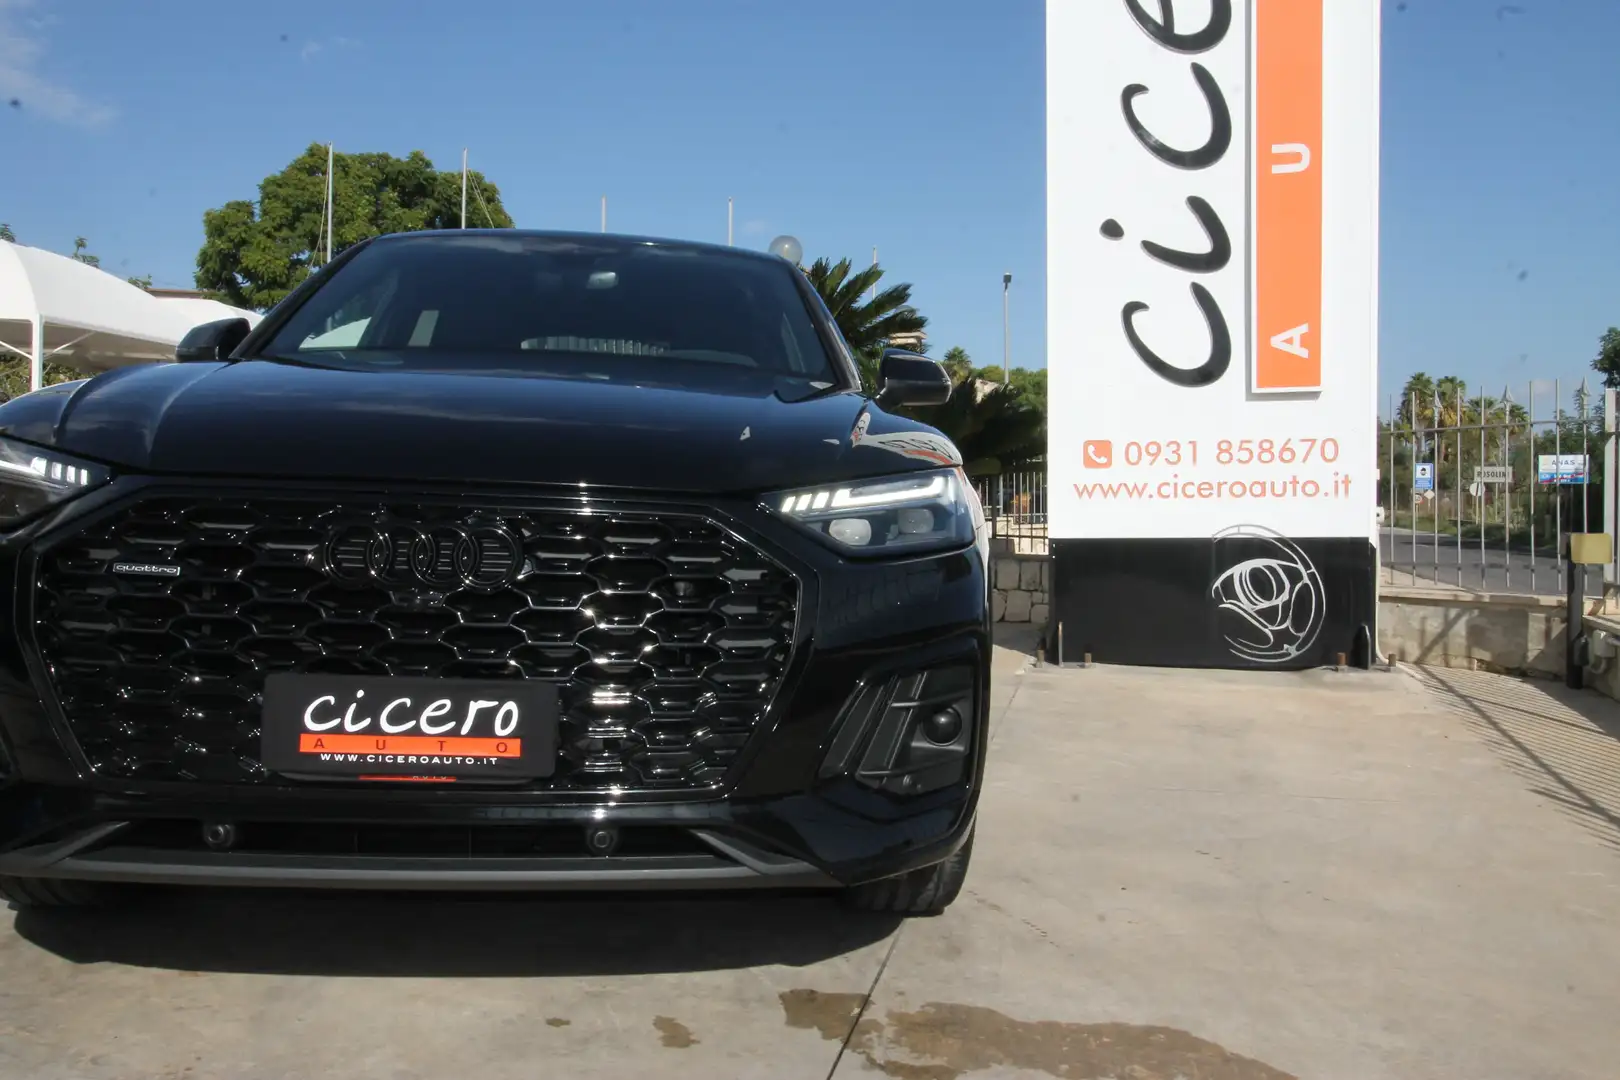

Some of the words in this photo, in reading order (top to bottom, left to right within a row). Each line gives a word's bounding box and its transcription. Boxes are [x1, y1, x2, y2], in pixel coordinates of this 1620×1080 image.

[1124, 440, 1198, 467] 0931
[1215, 437, 1340, 466] 858670
[1073, 471, 1352, 499] www.ciceroauto.it
[116, 565, 177, 573] quattro
[303, 689, 519, 737] cicero
[313, 738, 508, 753] AUTO
[320, 753, 498, 765] WWW.CICEROAUTO.IT
